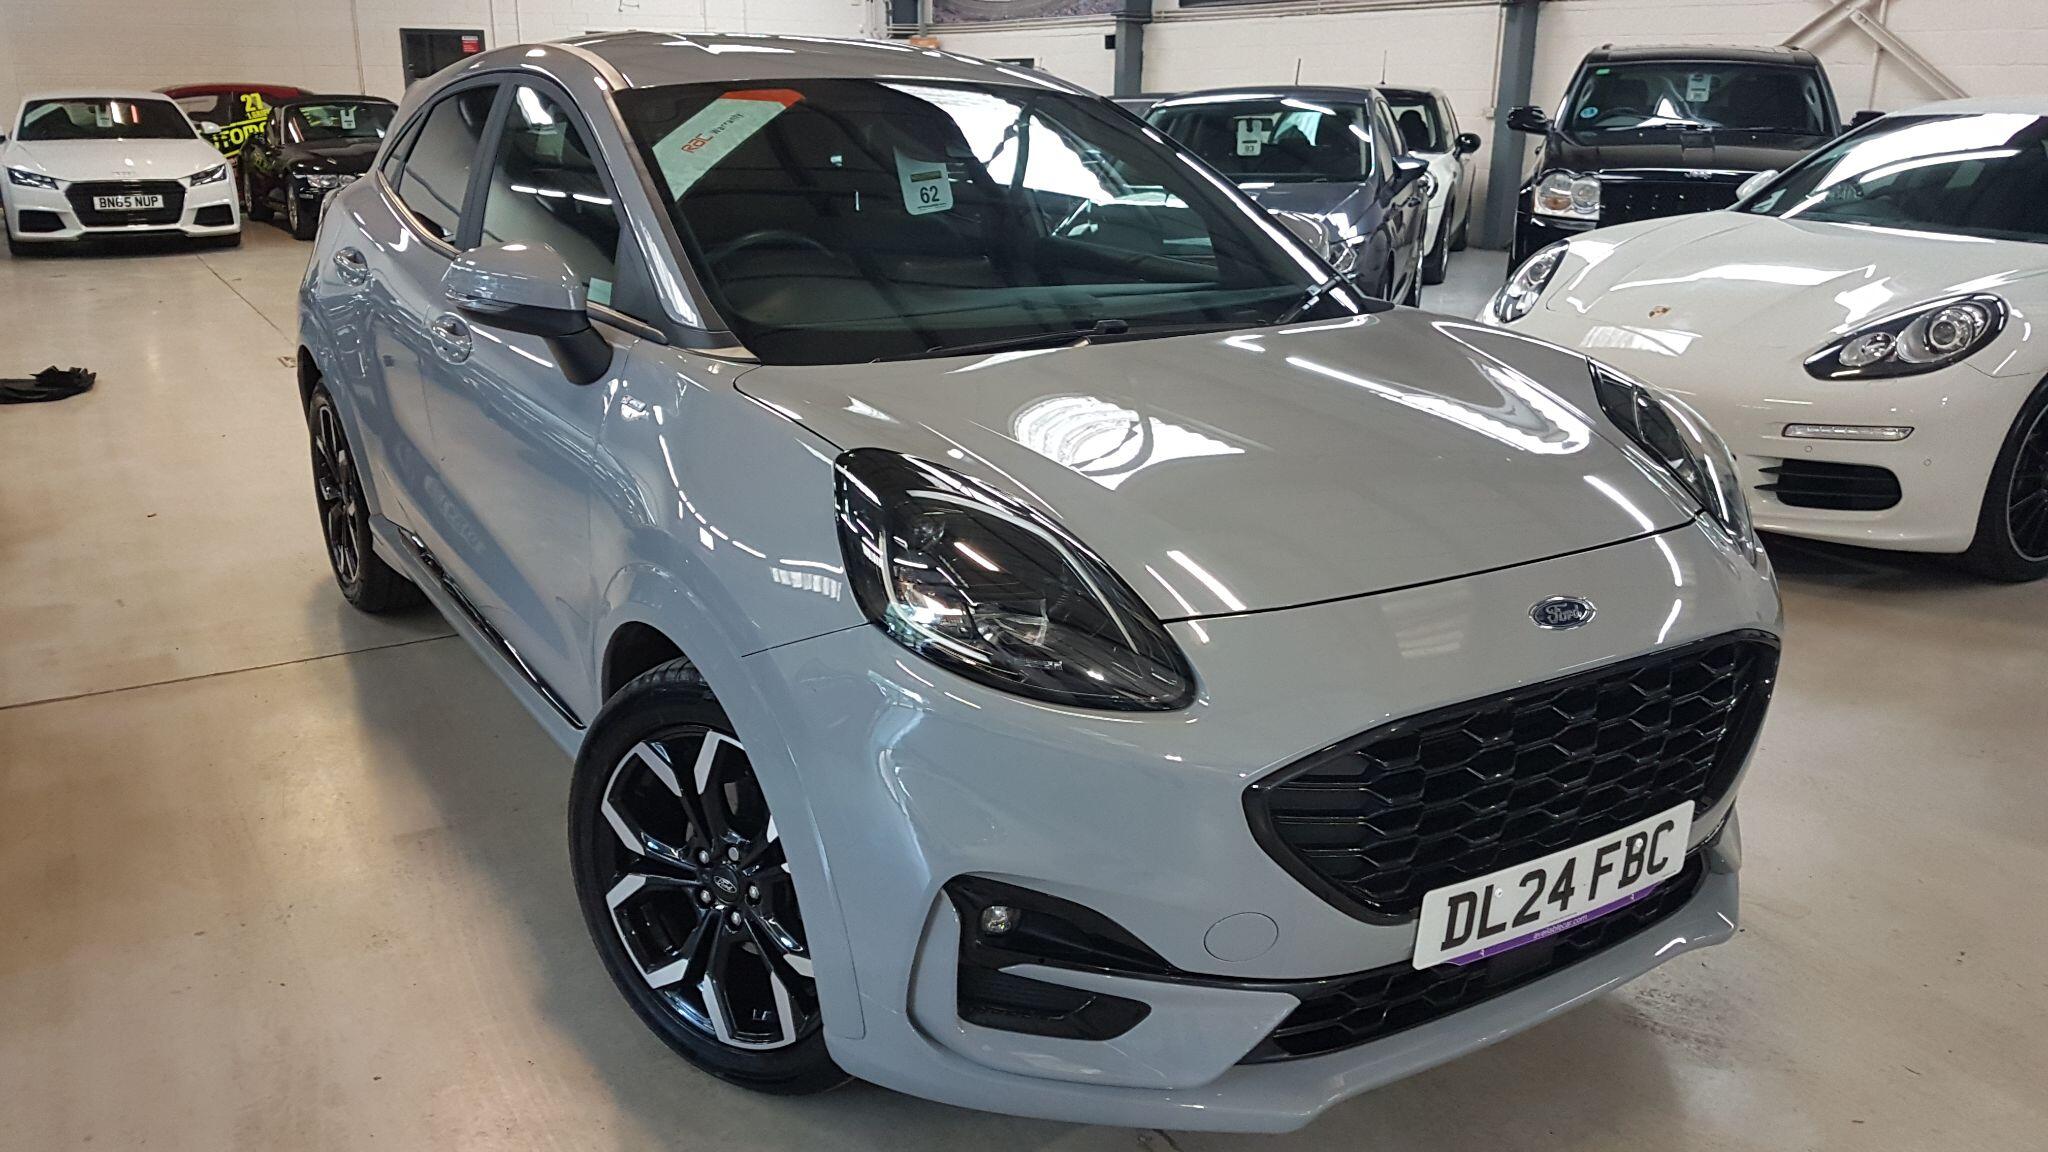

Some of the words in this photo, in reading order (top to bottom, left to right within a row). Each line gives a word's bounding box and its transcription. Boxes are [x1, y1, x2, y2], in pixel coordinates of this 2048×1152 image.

[710, 113, 744, 135] Warranty
[99, 197, 132, 208] BN65
[135, 196, 158, 207] NUP
[920, 185, 940, 203] 62
[1545, 602, 1583, 624] Ford
[1440, 857, 1577, 951] DL24
[1588, 819, 1675, 901] FBC
